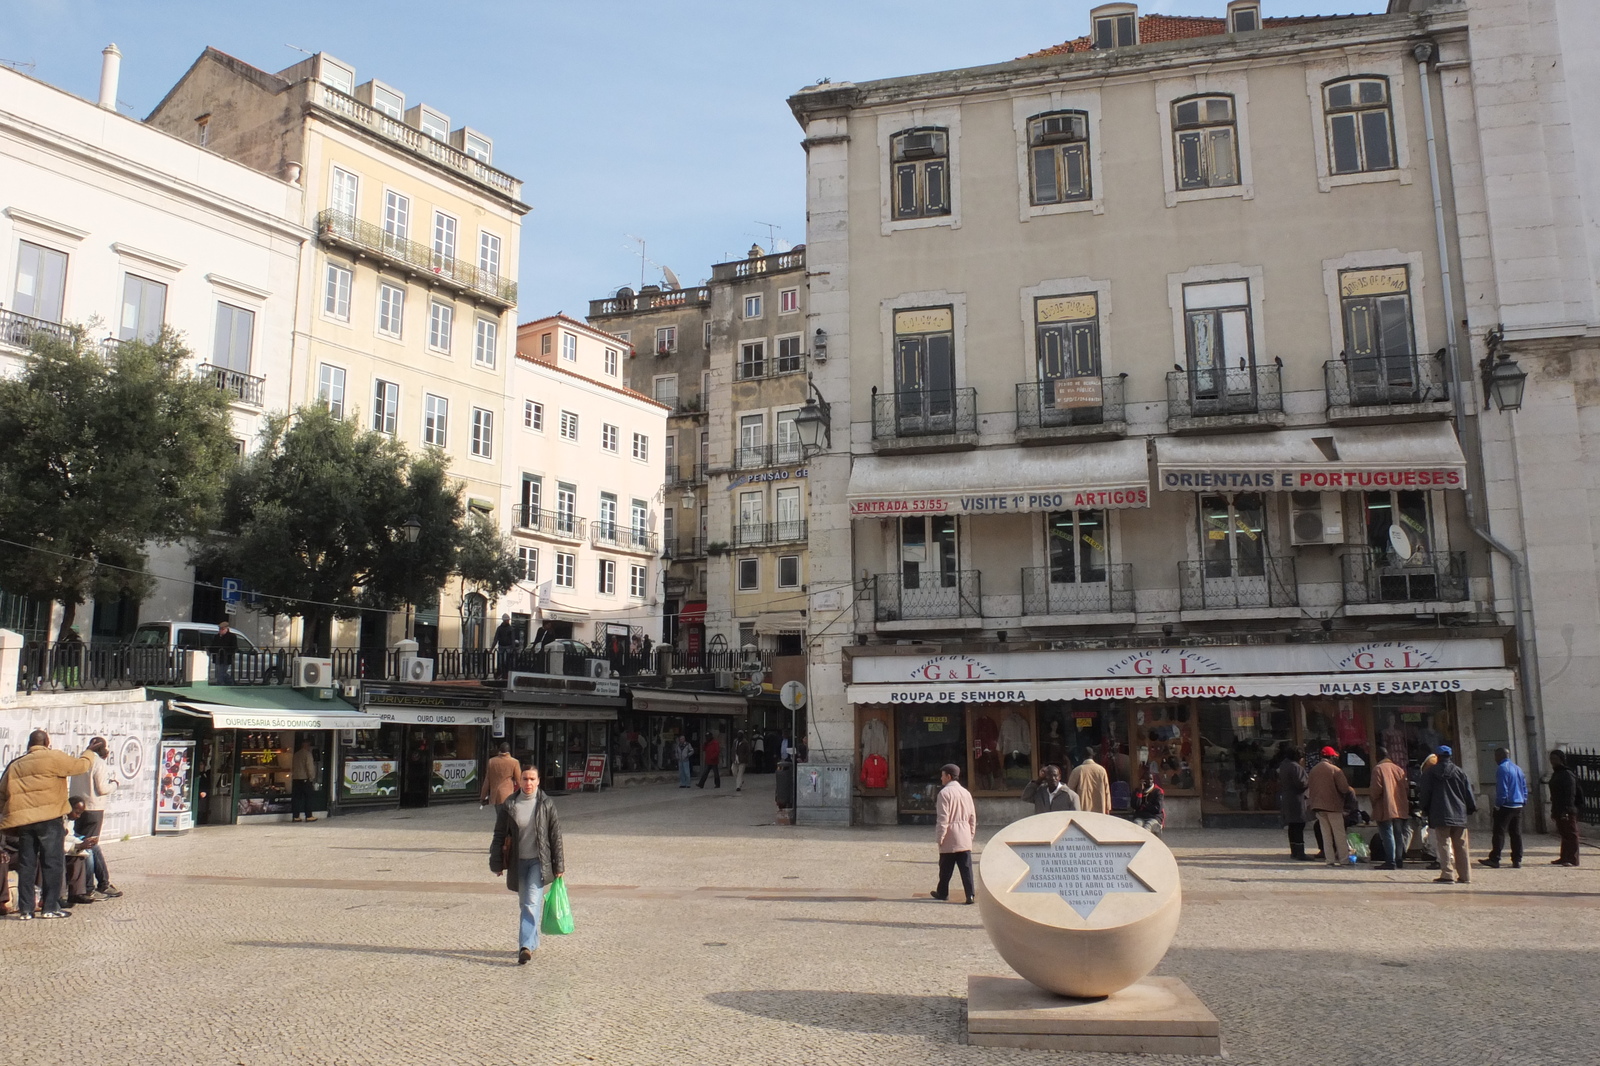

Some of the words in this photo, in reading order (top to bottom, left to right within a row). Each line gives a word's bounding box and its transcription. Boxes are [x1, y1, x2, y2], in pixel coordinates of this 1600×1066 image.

[747, 468, 790, 483] PENSÃO
[1165, 472, 1275, 487] ORIENTAIS
[1281, 473, 1293, 486] E
[1300, 470, 1460, 486] PORTUGUESES
[857, 501, 908, 512] ENTRADA
[913, 499, 943, 510] 53/55
[961, 496, 1008, 511] VISITE
[1029, 494, 1063, 508] PISO
[1074, 489, 1147, 506] ARTIGOS
[226, 580, 238, 598] P
[1134, 658, 1153, 675] G
[1161, 663, 1171, 674] &
[1180, 658, 1195, 674] L
[1355, 652, 1375, 670] G
[1384, 657, 1395, 669] &
[1403, 651, 1420, 668] L
[923, 664, 941, 680] G
[949, 669, 959, 679] &
[966, 663, 981, 679] L
[1084, 686, 1135, 697] HOMEM
[1145, 686, 1153, 696] E
[1171, 685, 1237, 697] CRIANÇA
[1319, 682, 1371, 693] MALAS
[1377, 682, 1386, 691] E
[1392, 679, 1461, 691] SAPATOS
[369, 695, 445, 705] OURIVESARIA
[891, 692, 934, 701] ROUPA
[939, 691, 956, 700] DE
[961, 690, 1026, 700] SENHORA
[226, 718, 271, 727] OURIVESARIA
[273, 718, 286, 728] SÃO
[287, 720, 321, 728] DOMINGOS
[372, 713, 395, 721] MPRA
[436, 715, 456, 723] USADO
[351, 771, 377, 782] OURO
[444, 769, 466, 779] OURO
[1051, 858, 1097, 866] INTOLERÂNCIA
